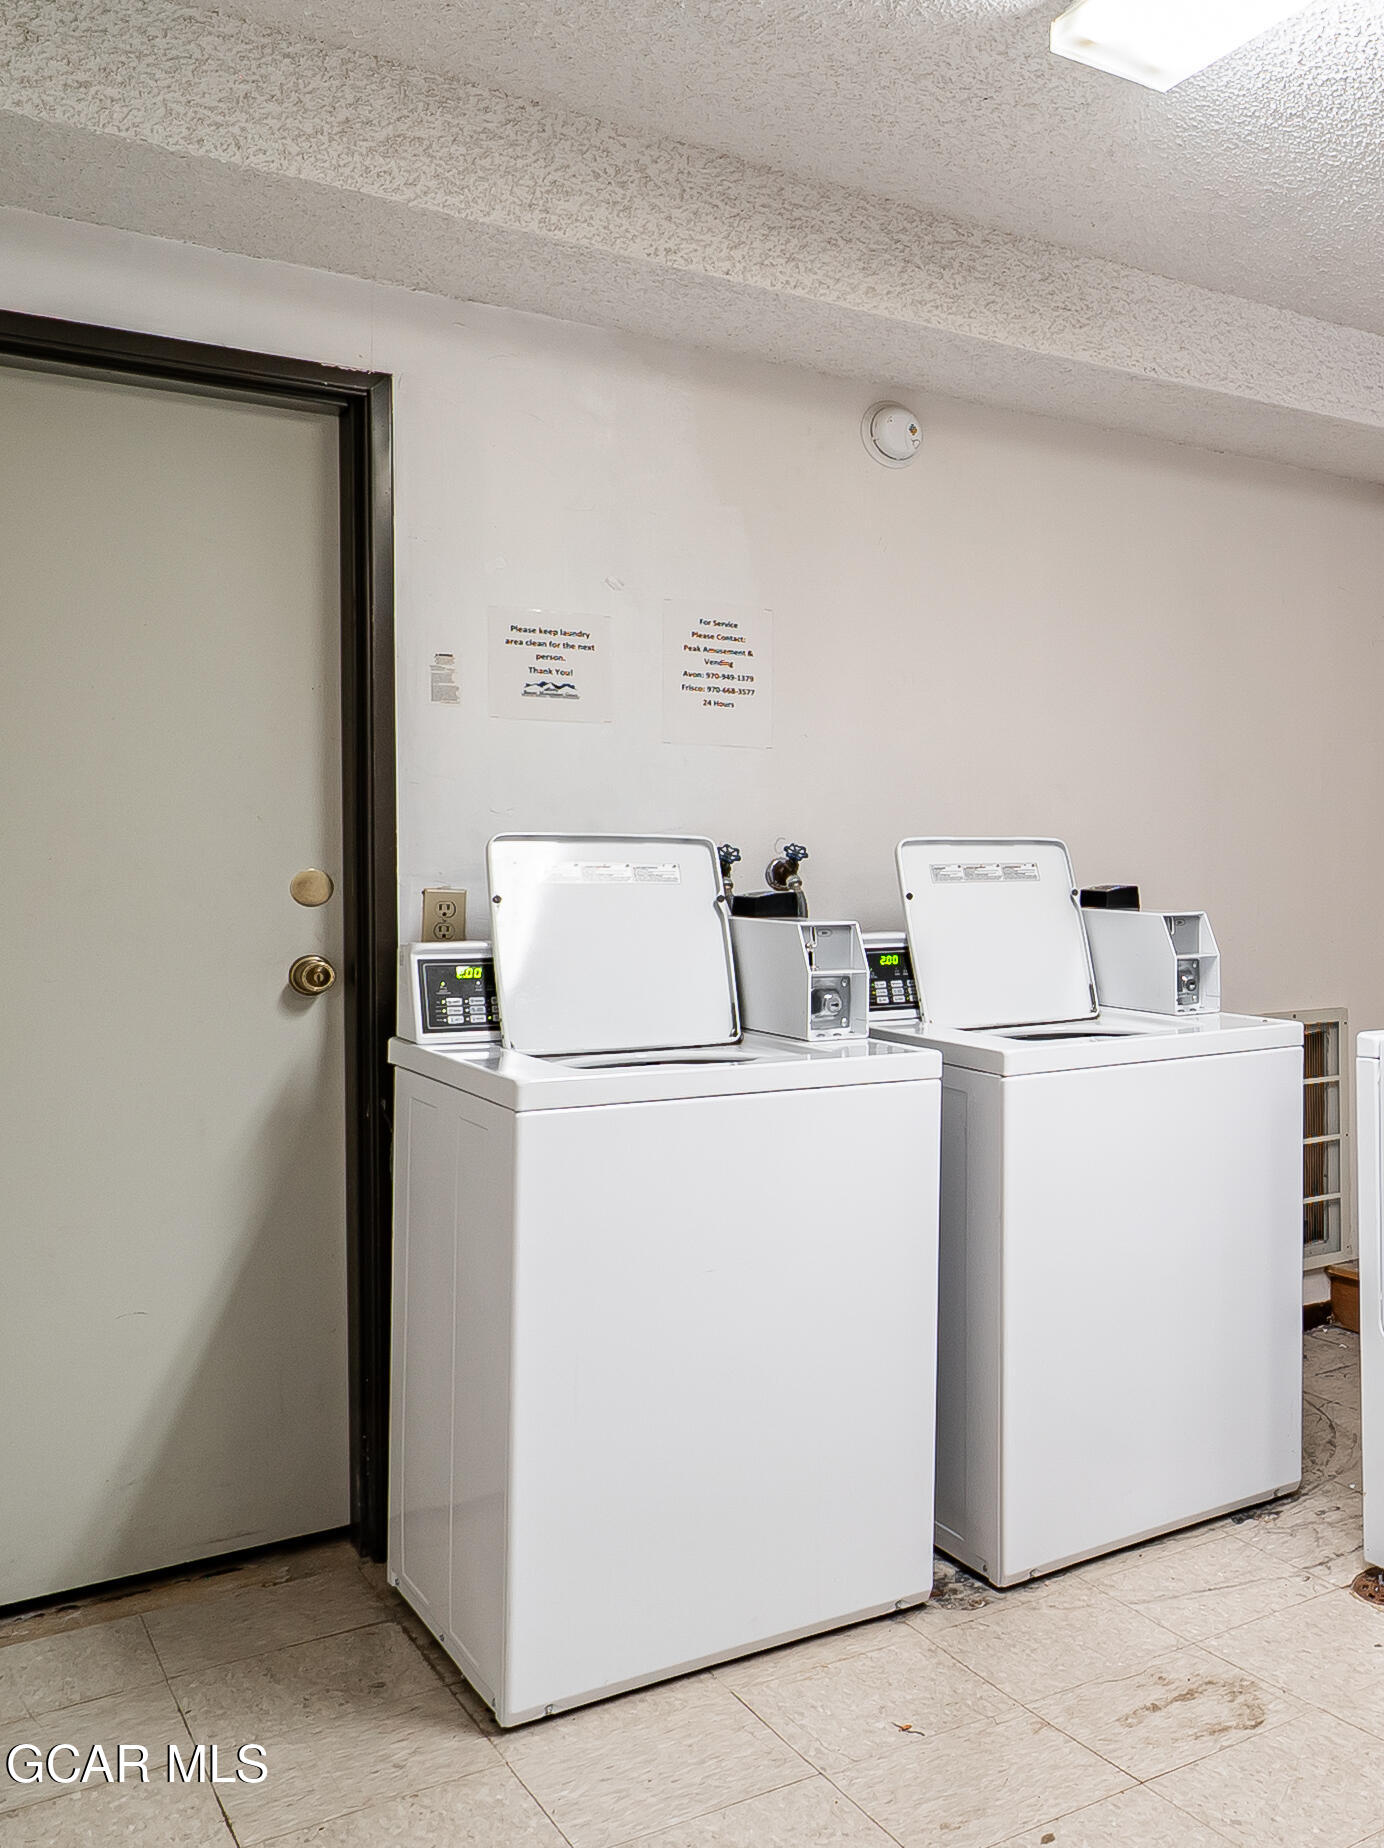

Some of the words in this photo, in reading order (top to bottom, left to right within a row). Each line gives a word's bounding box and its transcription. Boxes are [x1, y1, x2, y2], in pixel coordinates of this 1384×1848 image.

[699, 618, 711, 626] For
[713, 620, 738, 628] Service
[510, 625, 536, 634] Please
[539, 627, 558, 637] keep
[560, 629, 590, 639] laundry
[691, 631, 715, 640] Please
[716, 633, 746, 643] Contact:
[525, 639, 547, 647] clean
[549, 640, 560, 648] for
[562, 641, 576, 649] the
[578, 643, 595, 651] next
[683, 644, 701, 652] Peak
[703, 646, 746, 656] Amusement
[704, 658, 734, 669] Vending
[528, 666, 553, 675] Thank
[555, 668, 574, 677] You!
[683, 670, 704, 678] Avon:
[705, 672, 754, 682] 970-949-1379
[682, 684, 705, 692] Frisco:
[703, 698, 712, 706] 24
[713, 700, 735, 708] Hours
